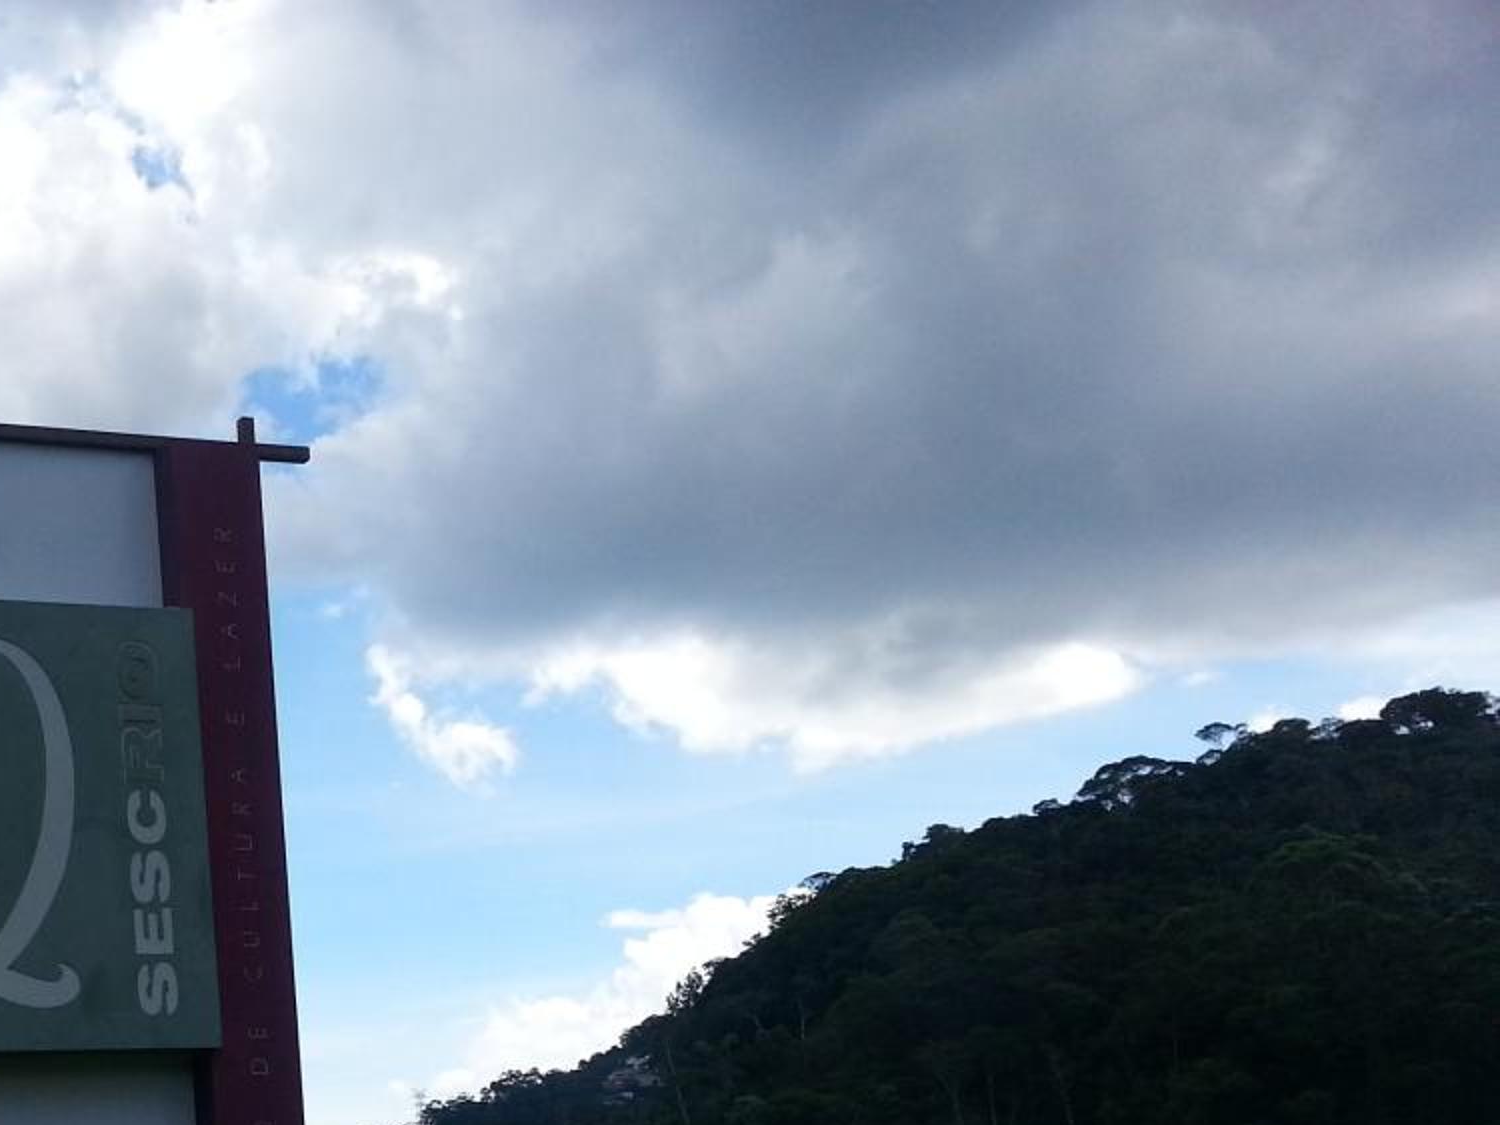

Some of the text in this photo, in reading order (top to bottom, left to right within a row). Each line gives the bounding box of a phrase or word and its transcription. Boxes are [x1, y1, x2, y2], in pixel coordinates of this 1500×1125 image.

[214, 527, 242, 672] LAZER
[227, 709, 245, 727] E
[231, 767, 264, 982] CULTURA
[248, 1026, 271, 1077] DE
